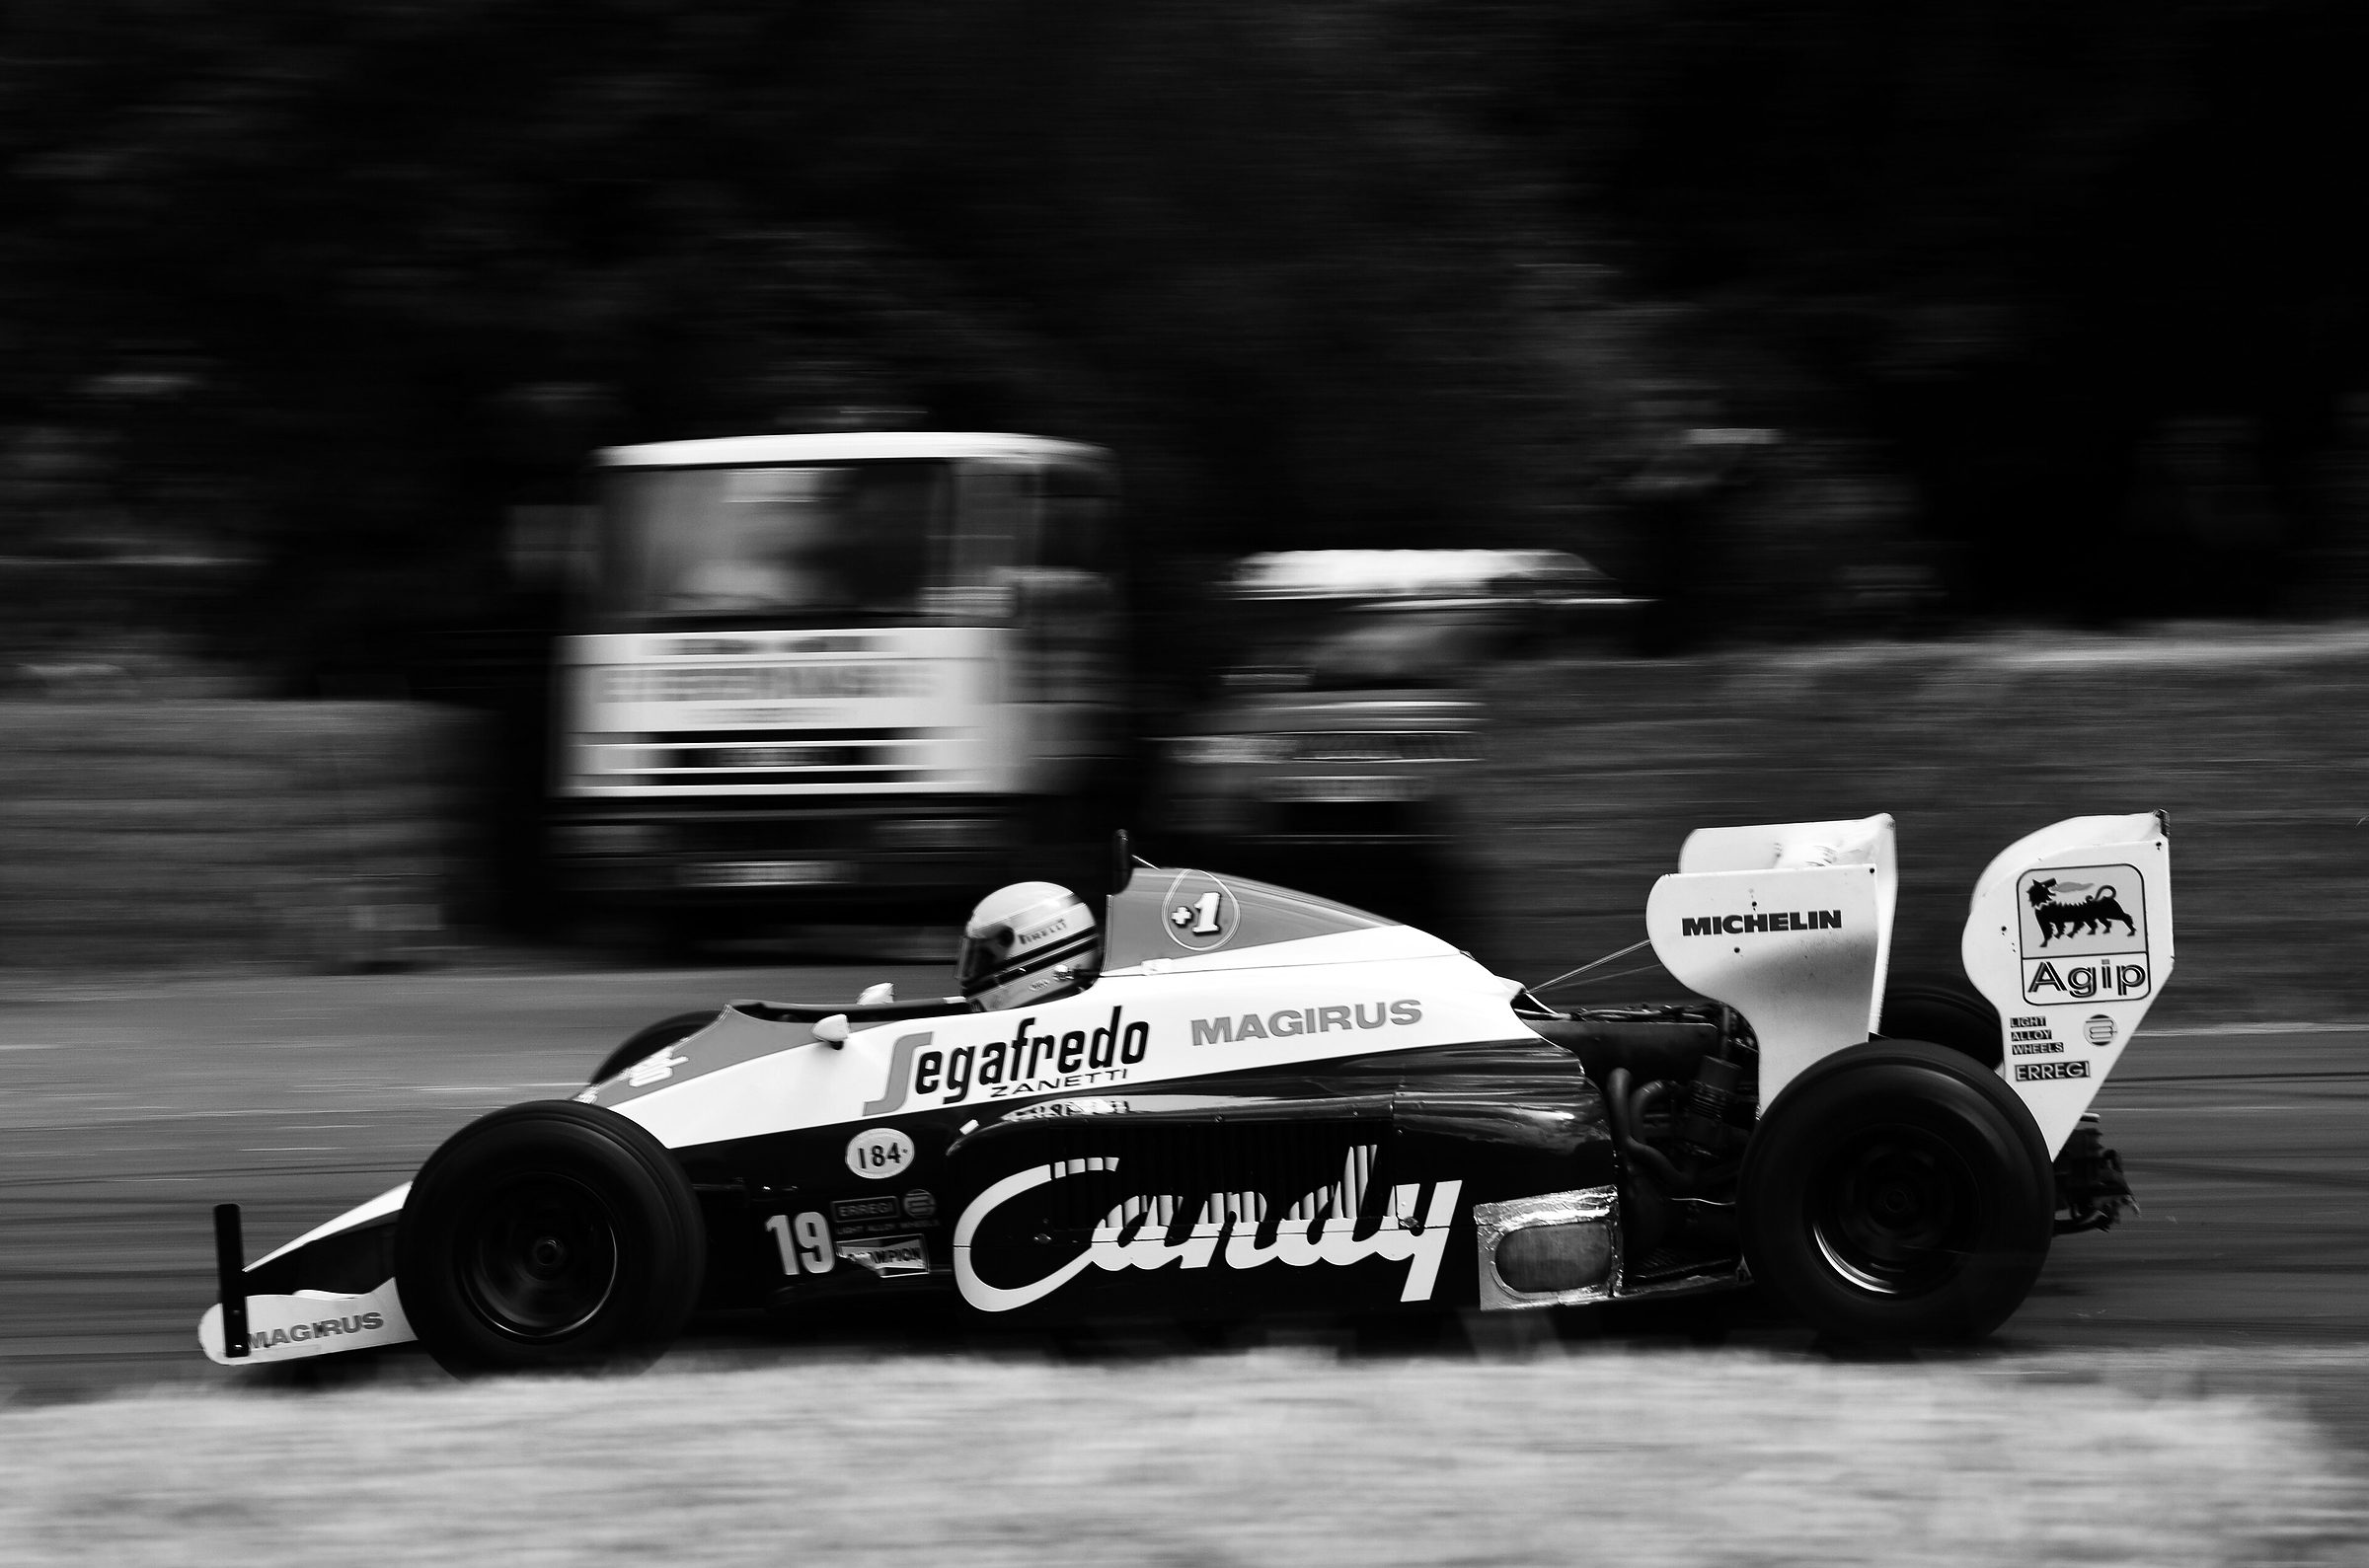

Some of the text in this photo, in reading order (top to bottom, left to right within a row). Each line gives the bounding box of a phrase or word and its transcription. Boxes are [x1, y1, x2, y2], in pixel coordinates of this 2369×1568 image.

[1682, 910, 1842, 936] MICHELIN
[2027, 959, 2146, 999] Agip
[1190, 999, 1422, 1046] MAGIRUS
[2010, 1016, 2046, 1028] LIGHT
[2012, 1030, 2051, 1042] ALLOY
[862, 1006, 1149, 1116] Segafredo
[2012, 1042, 2064, 1055] WHEELS
[990, 1069, 1127, 1097] ZANETTI
[2016, 1061, 2090, 1082] ERREGI
[764, 1211, 835, 1275] 19
[953, 1144, 1463, 1311] Candy
[247, 1311, 384, 1348] MAGIRUS
